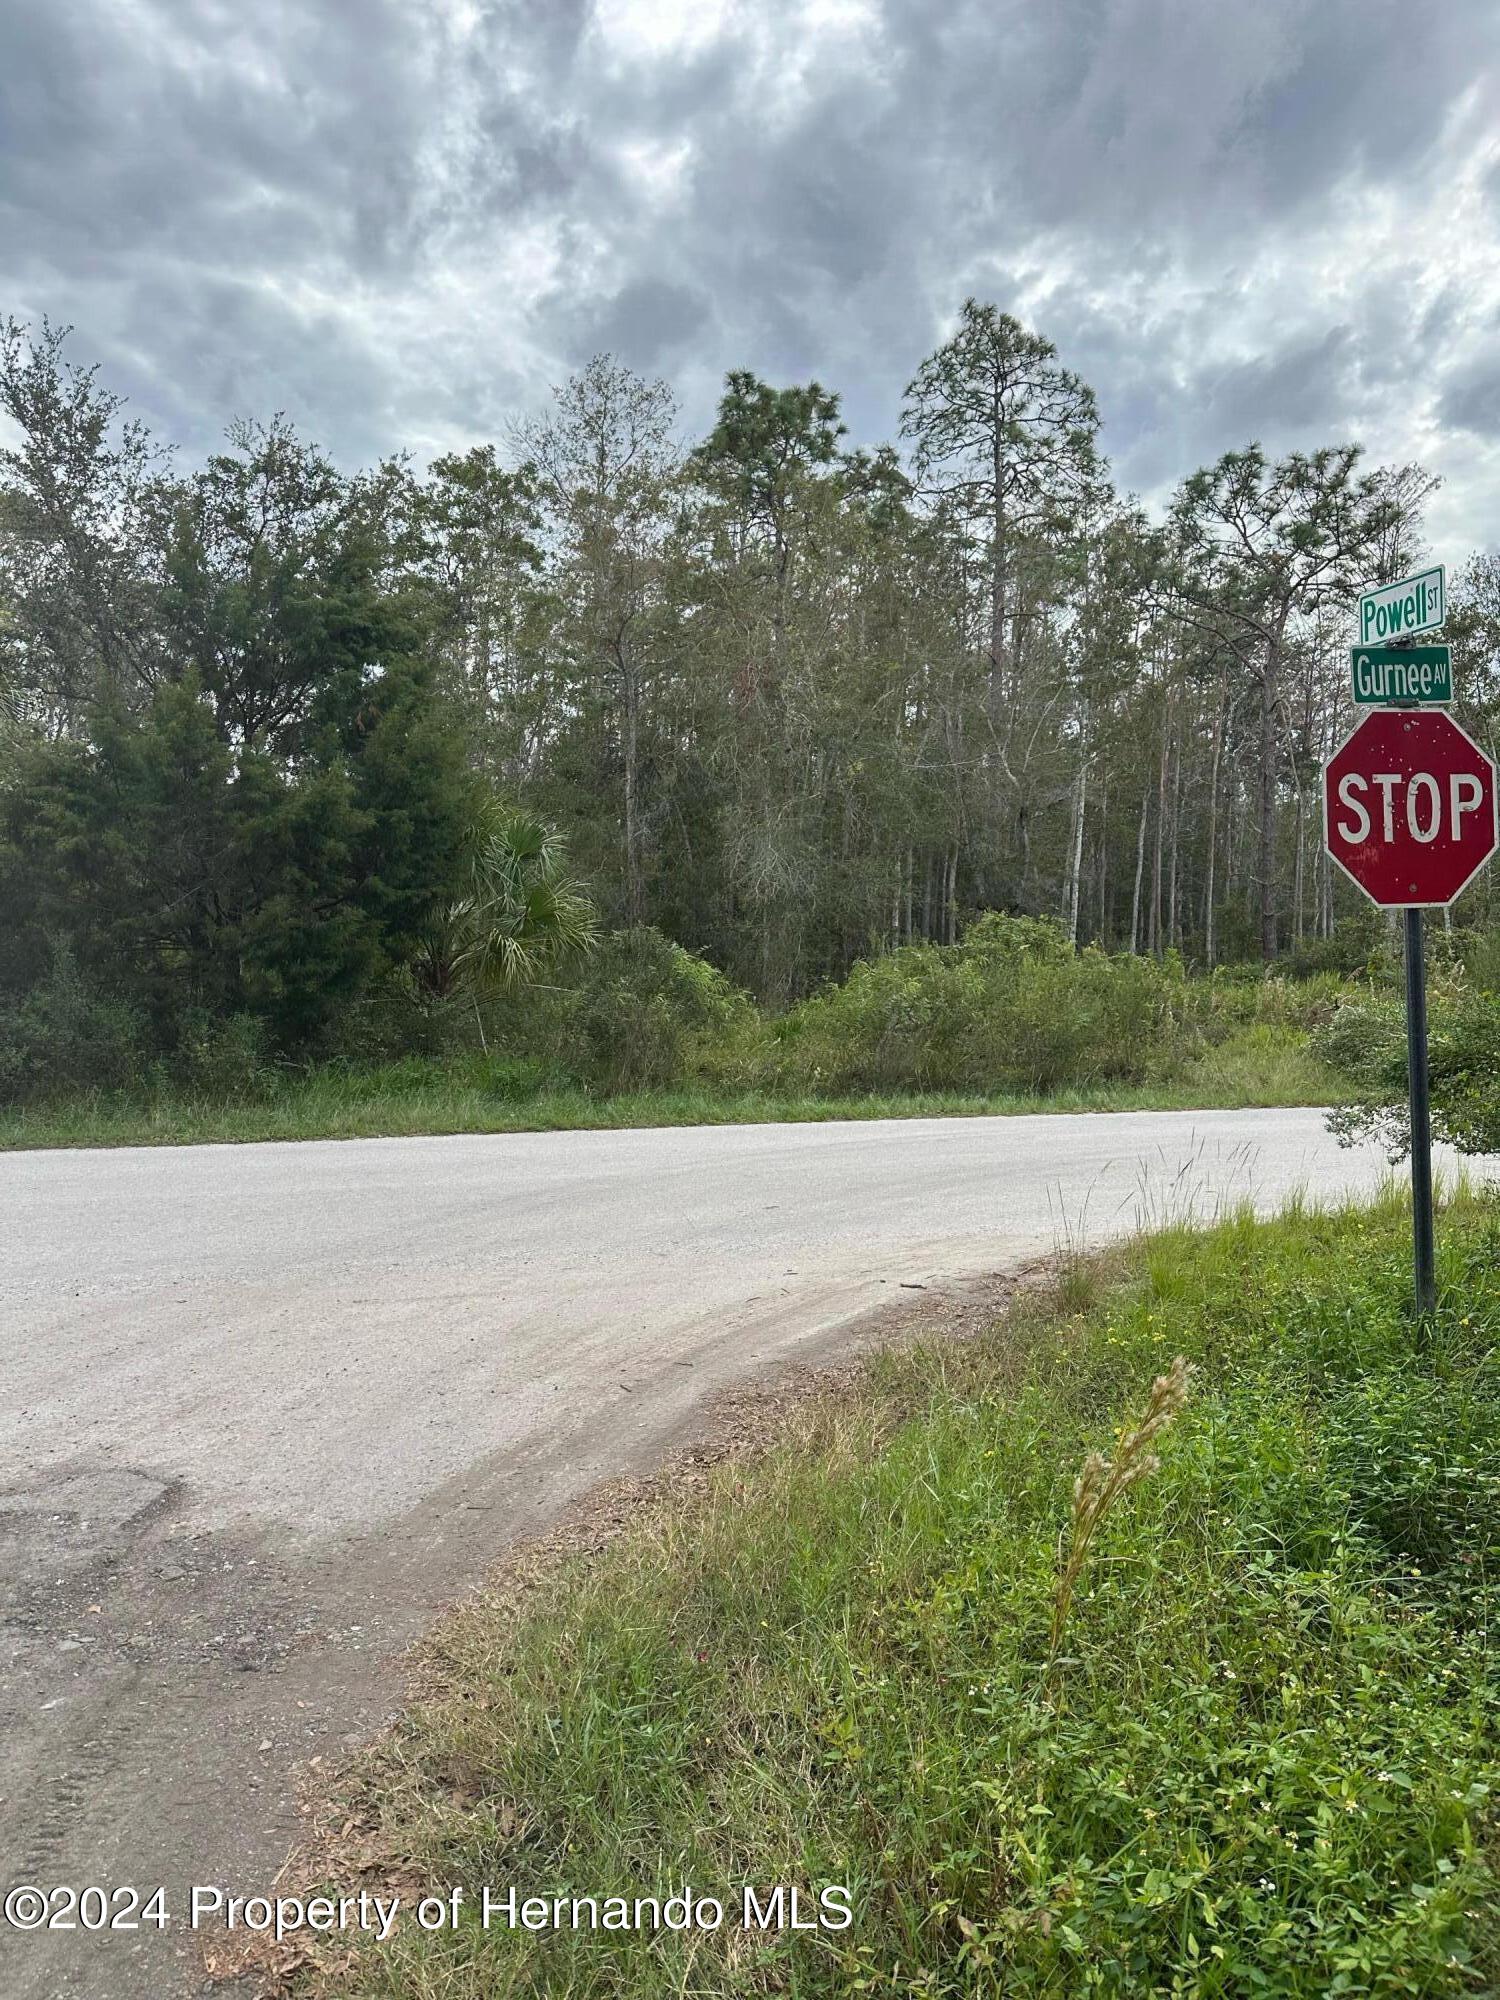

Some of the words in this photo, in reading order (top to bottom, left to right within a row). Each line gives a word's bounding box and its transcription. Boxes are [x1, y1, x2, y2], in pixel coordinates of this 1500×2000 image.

[1363, 581, 1427, 641] Powell
[1427, 587, 1439, 611] ST
[1357, 654, 1432, 697] Gurnee
[1433, 663, 1447, 685] AV
[1337, 772, 1484, 844] STOP
